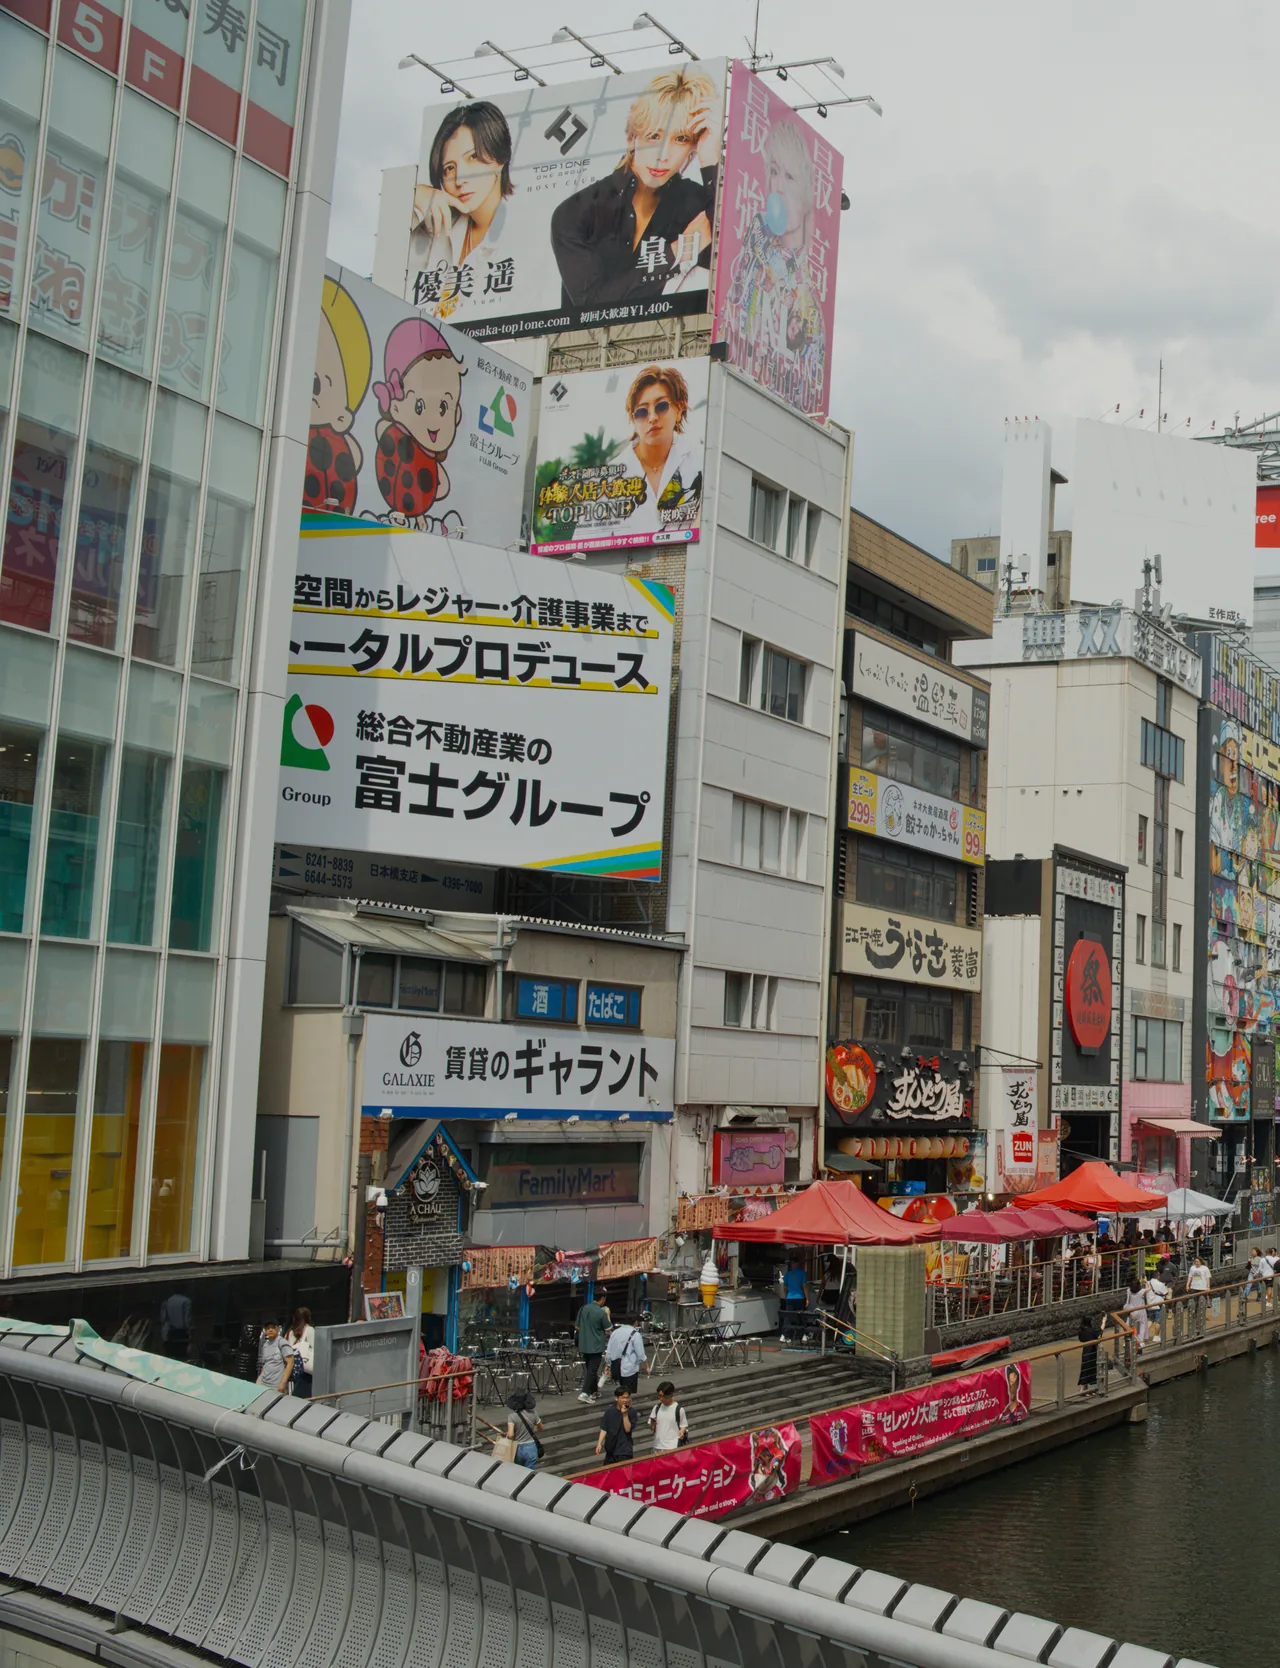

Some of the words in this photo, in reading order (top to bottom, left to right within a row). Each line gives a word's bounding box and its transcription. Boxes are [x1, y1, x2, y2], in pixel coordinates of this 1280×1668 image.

[72, 2, 166, 82] 5F
[533, 158, 591, 173] TOP1ONE
[735, 77, 771, 240] 最強
[527, 181, 557, 192] HOST
[565, 176, 596, 187] CLUB
[810, 137, 834, 302] 最高
[635, 231, 700, 274] 皐月
[477, 356, 527, 392] 総合不動産業の
[469, 433, 521, 467] 富士グループ
[479, 455, 492, 469] FUJI
[492, 462, 508, 476] Group
[538, 477, 644, 506] 体験入店大歓迎
[290, 629, 652, 692] ータルプロデュース
[912, 673, 959, 726] 温野菜
[355, 710, 553, 767] 総合不動産業の
[281, 785, 332, 809] Group
[354, 754, 652, 839] 富士グループ
[852, 782, 875, 799] 生ビール
[849, 800, 871, 825] 299
[905, 812, 960, 846] 餃子のかっちゃん
[305, 852, 354, 873] 6241-8839
[369, 864, 419, 884] 日本橋支店
[304, 870, 354, 890] 6644-5573
[865, 917, 949, 979] うなぎ
[1079, 949, 1106, 1008] 祭
[532, 984, 549, 1015] 酒
[588, 990, 625, 1020] たばこ
[382, 1072, 435, 1088] GALAXIE
[444, 1038, 659, 1098] 賃貸のギャラント
[1014, 1141, 1032, 1151] ZUN
[518, 1166, 617, 1198] FamilyMart
[355, 1335, 397, 1350] information
